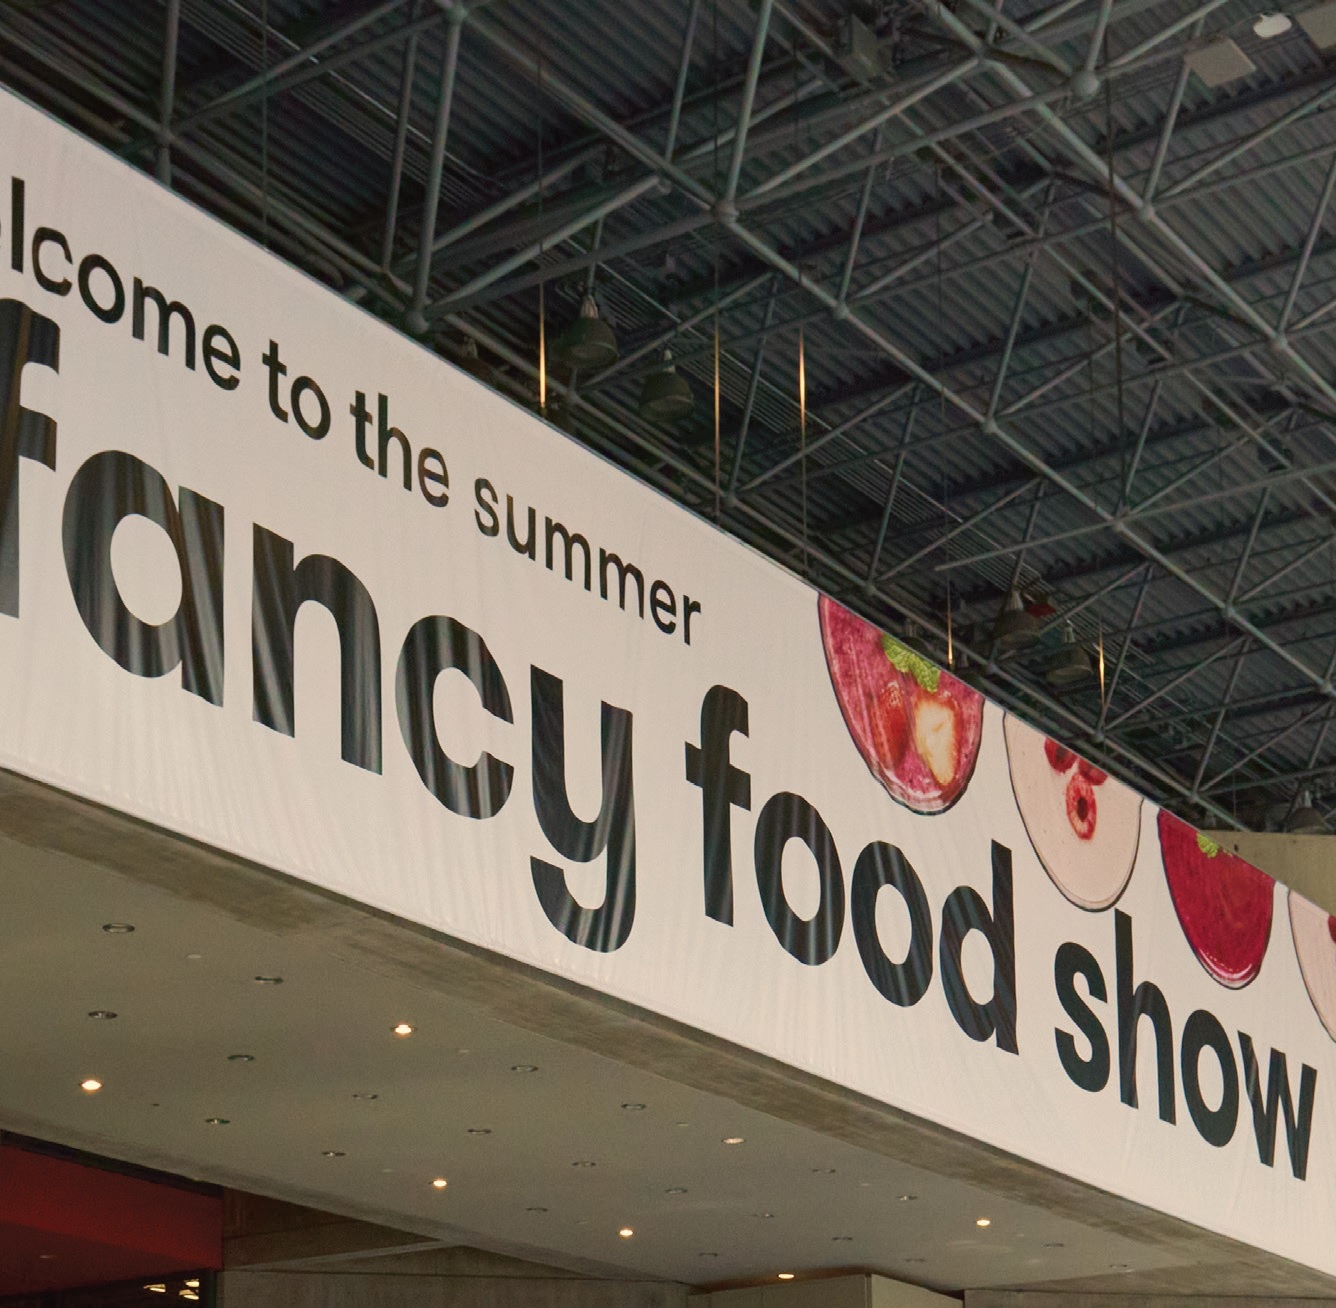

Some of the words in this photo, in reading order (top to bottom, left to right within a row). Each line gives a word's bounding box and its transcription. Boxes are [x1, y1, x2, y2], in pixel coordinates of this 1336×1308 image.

[0, 176, 241, 391] lcome
[262, 339, 331, 440] to
[350, 391, 450, 507] the
[474, 476, 701, 646] summer
[684, 684, 1019, 1055] food
[1054, 908, 1318, 1181] show
